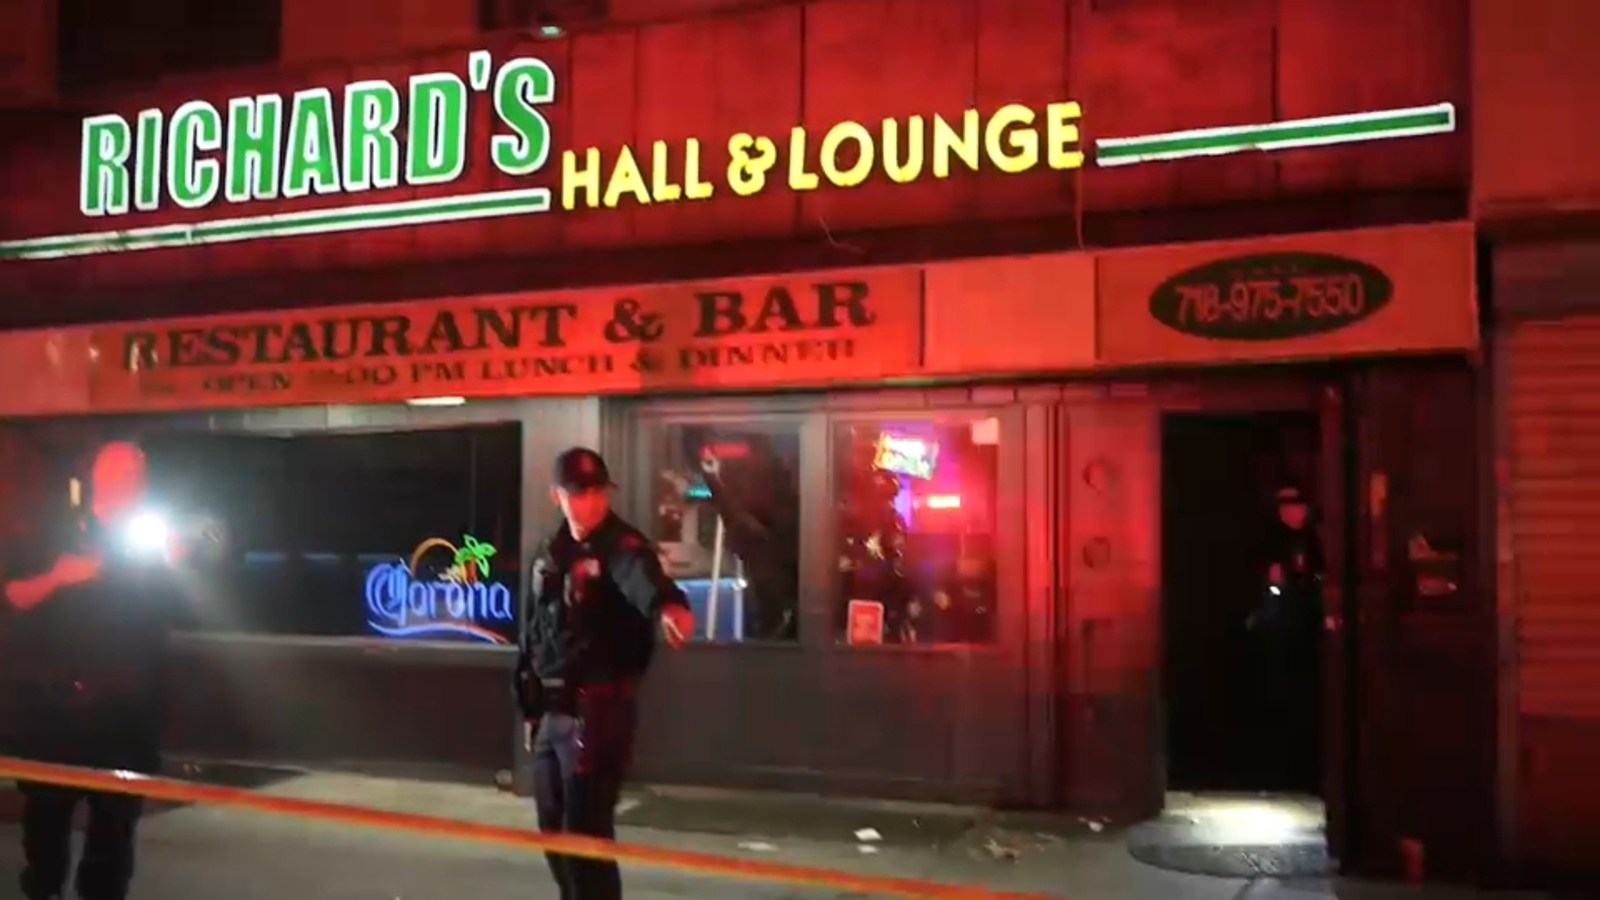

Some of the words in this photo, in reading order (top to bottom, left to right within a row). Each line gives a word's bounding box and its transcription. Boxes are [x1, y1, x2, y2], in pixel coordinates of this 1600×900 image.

[80, 51, 555, 216] RICHARD'S
[562, 137, 713, 210] HALL
[727, 133, 776, 195] &
[788, 101, 1084, 190] LOUNGE
[122, 304, 578, 373] RESTAURANT
[604, 298, 664, 344] &
[693, 281, 877, 338] BAR
[366, 562, 513, 628] Corona
